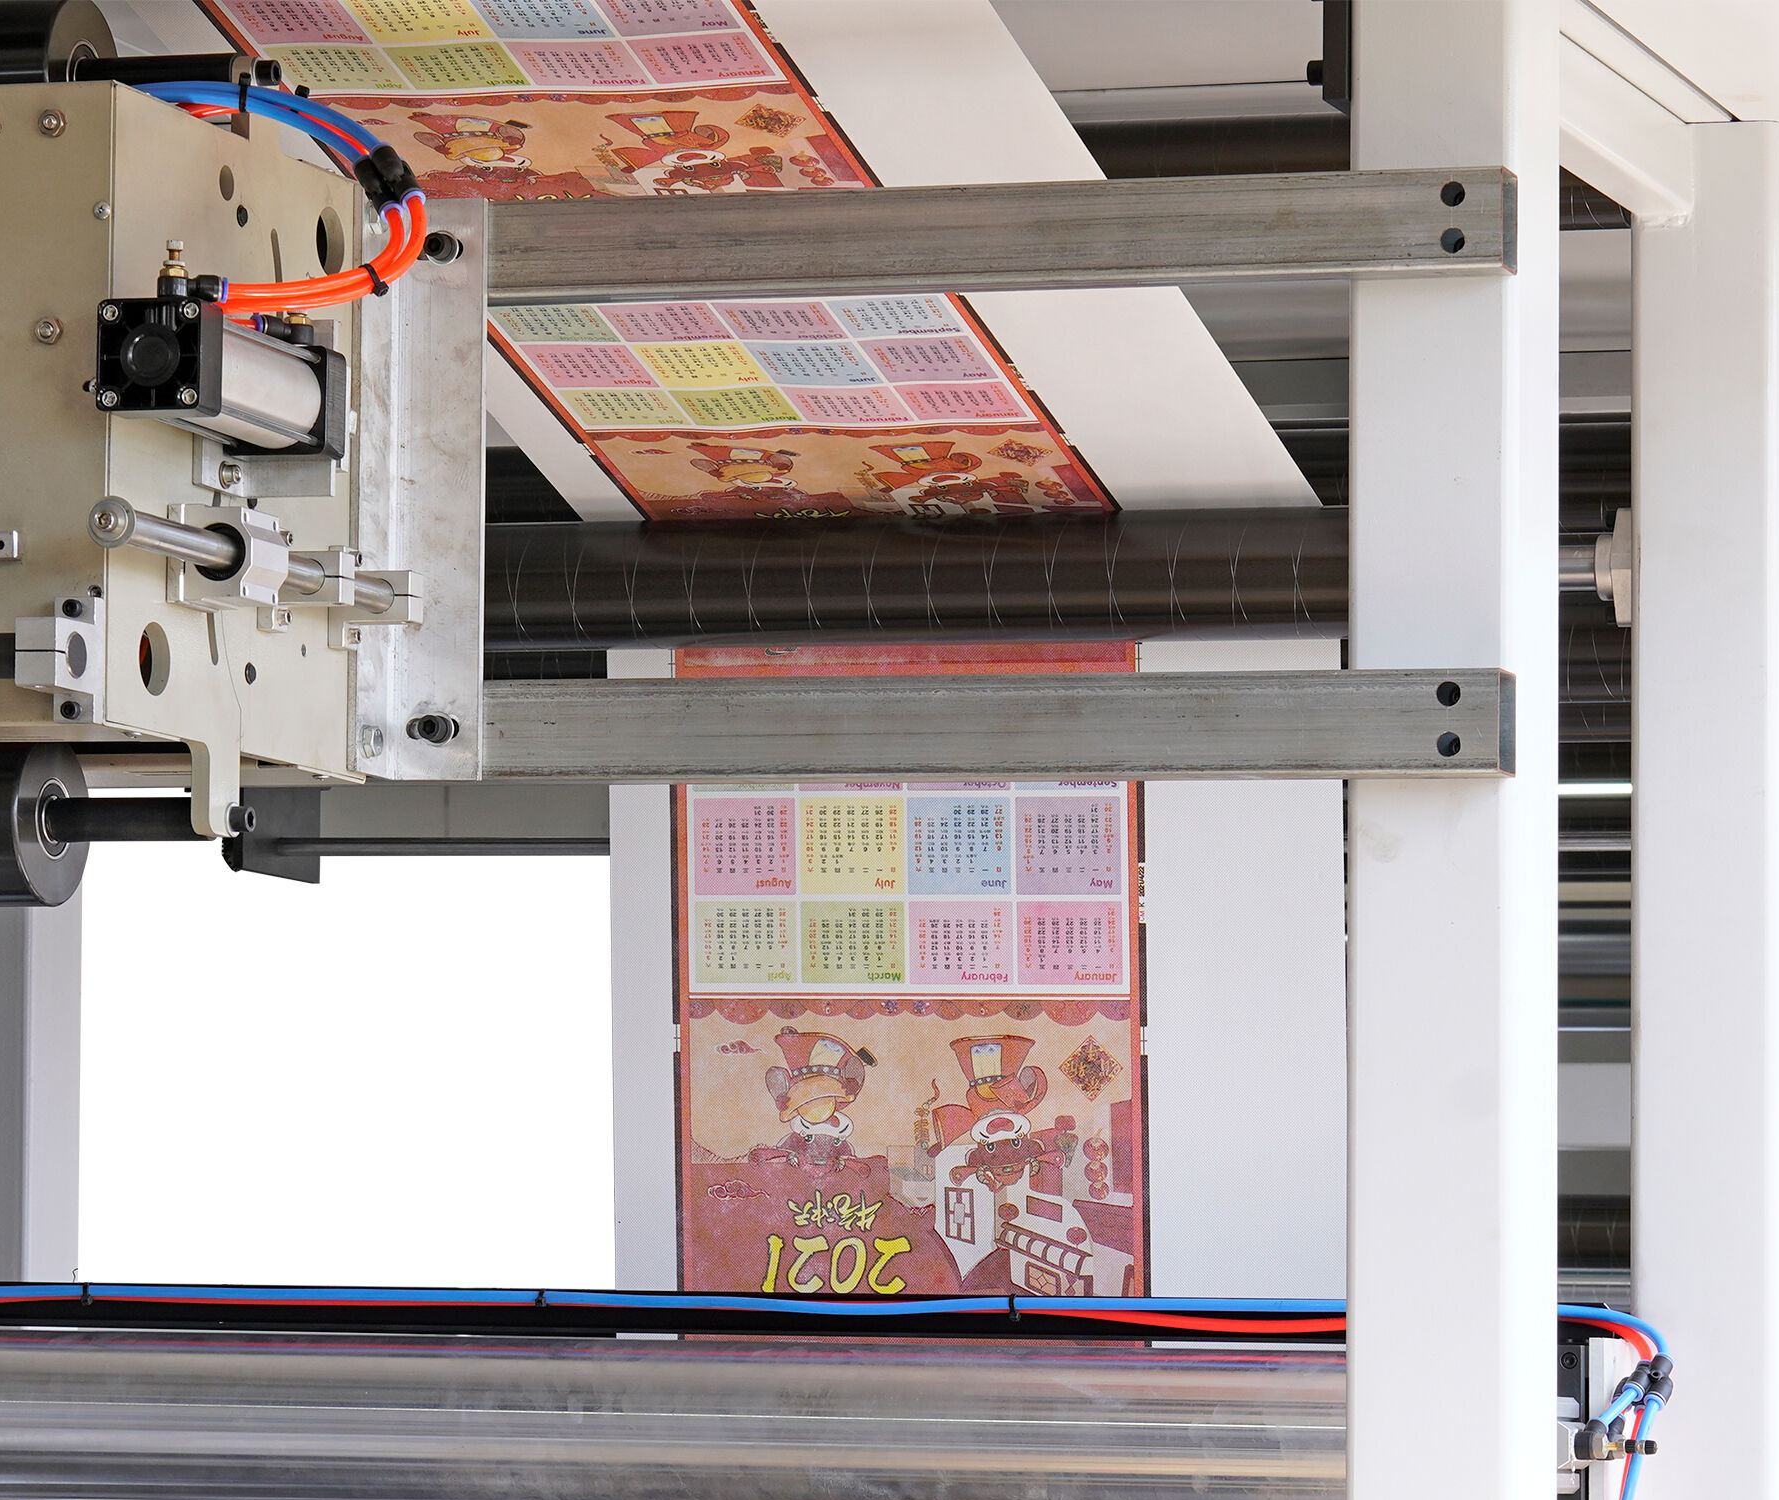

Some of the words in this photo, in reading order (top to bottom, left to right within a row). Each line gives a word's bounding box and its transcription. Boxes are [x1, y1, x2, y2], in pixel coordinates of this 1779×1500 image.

[702, 19, 728, 27] May
[457, 28, 481, 36] July
[323, 33, 363, 42] August
[718, 69, 766, 78] January
[897, 327, 960, 335] September
[963, 371, 987, 379] May
[756, 878, 792, 889] August
[875, 878, 895, 889] July
[981, 880, 1007, 889] June
[1090, 878, 1113, 888] May
[768, 971, 792, 981] April
[867, 973, 901, 981] March
[961, 971, 1008, 982] February
[1074, 971, 1117, 982] January
[760, 1234, 912, 1295] 2021
